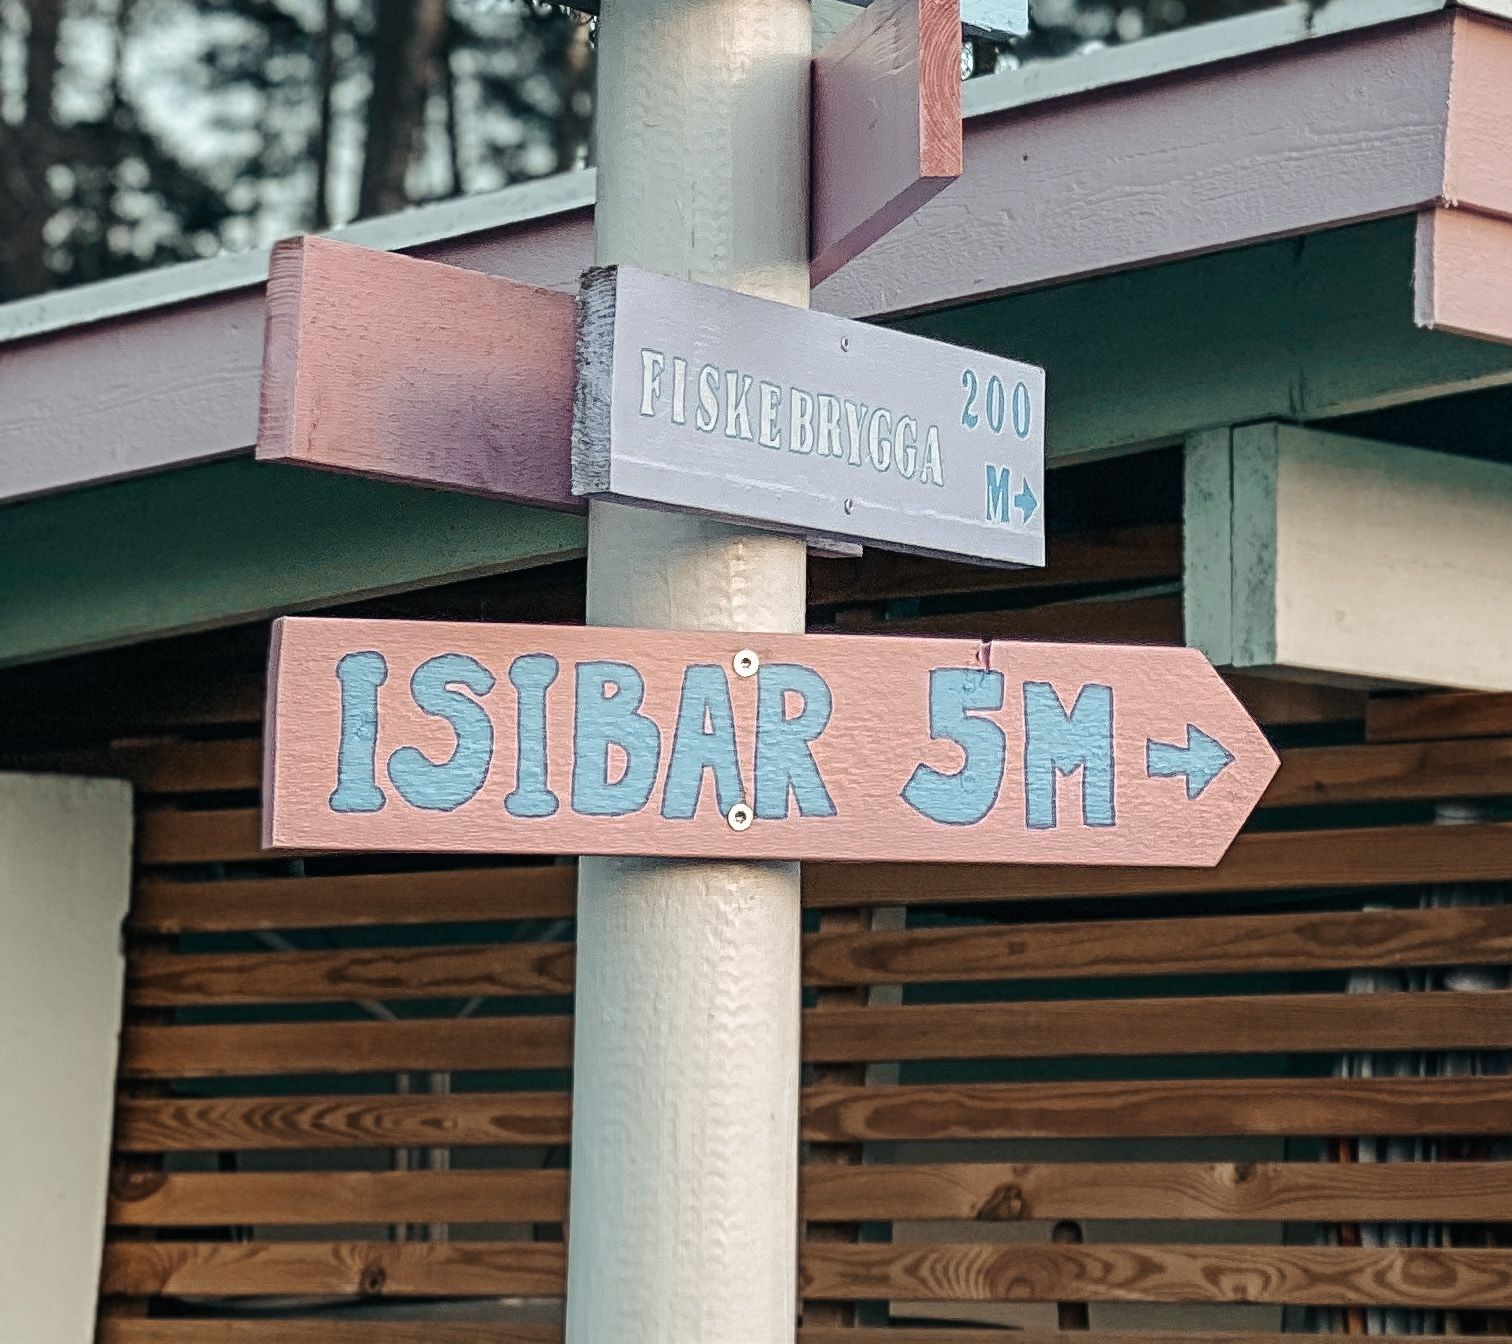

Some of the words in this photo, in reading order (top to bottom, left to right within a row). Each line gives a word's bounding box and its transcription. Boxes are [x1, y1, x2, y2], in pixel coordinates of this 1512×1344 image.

[641, 348, 943, 487] FISKEBRYGGA
[962, 369, 1030, 438] 200
[987, 465, 1010, 523] M
[329, 650, 837, 820] ISIBAR
[901, 667, 1115, 829] 5M
